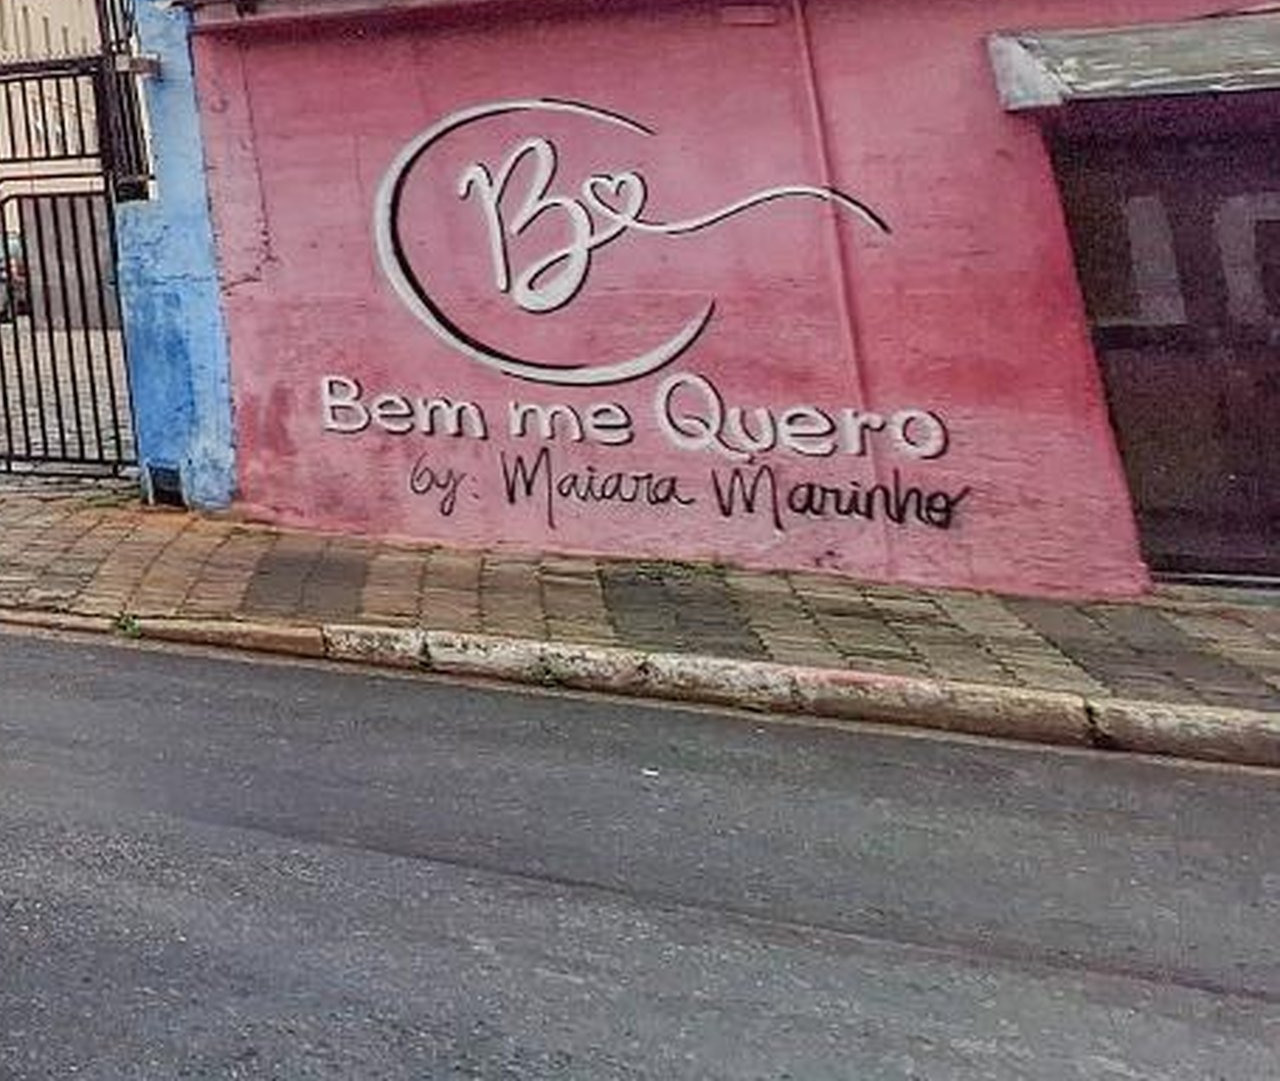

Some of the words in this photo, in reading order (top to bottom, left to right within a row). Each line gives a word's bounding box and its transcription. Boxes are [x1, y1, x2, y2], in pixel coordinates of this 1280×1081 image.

[322, 375, 488, 440] Bem
[509, 400, 634, 445] me
[655, 373, 950, 461] Quero
[500, 446, 696, 529] Maiara
[711, 464, 972, 531] Marinho
